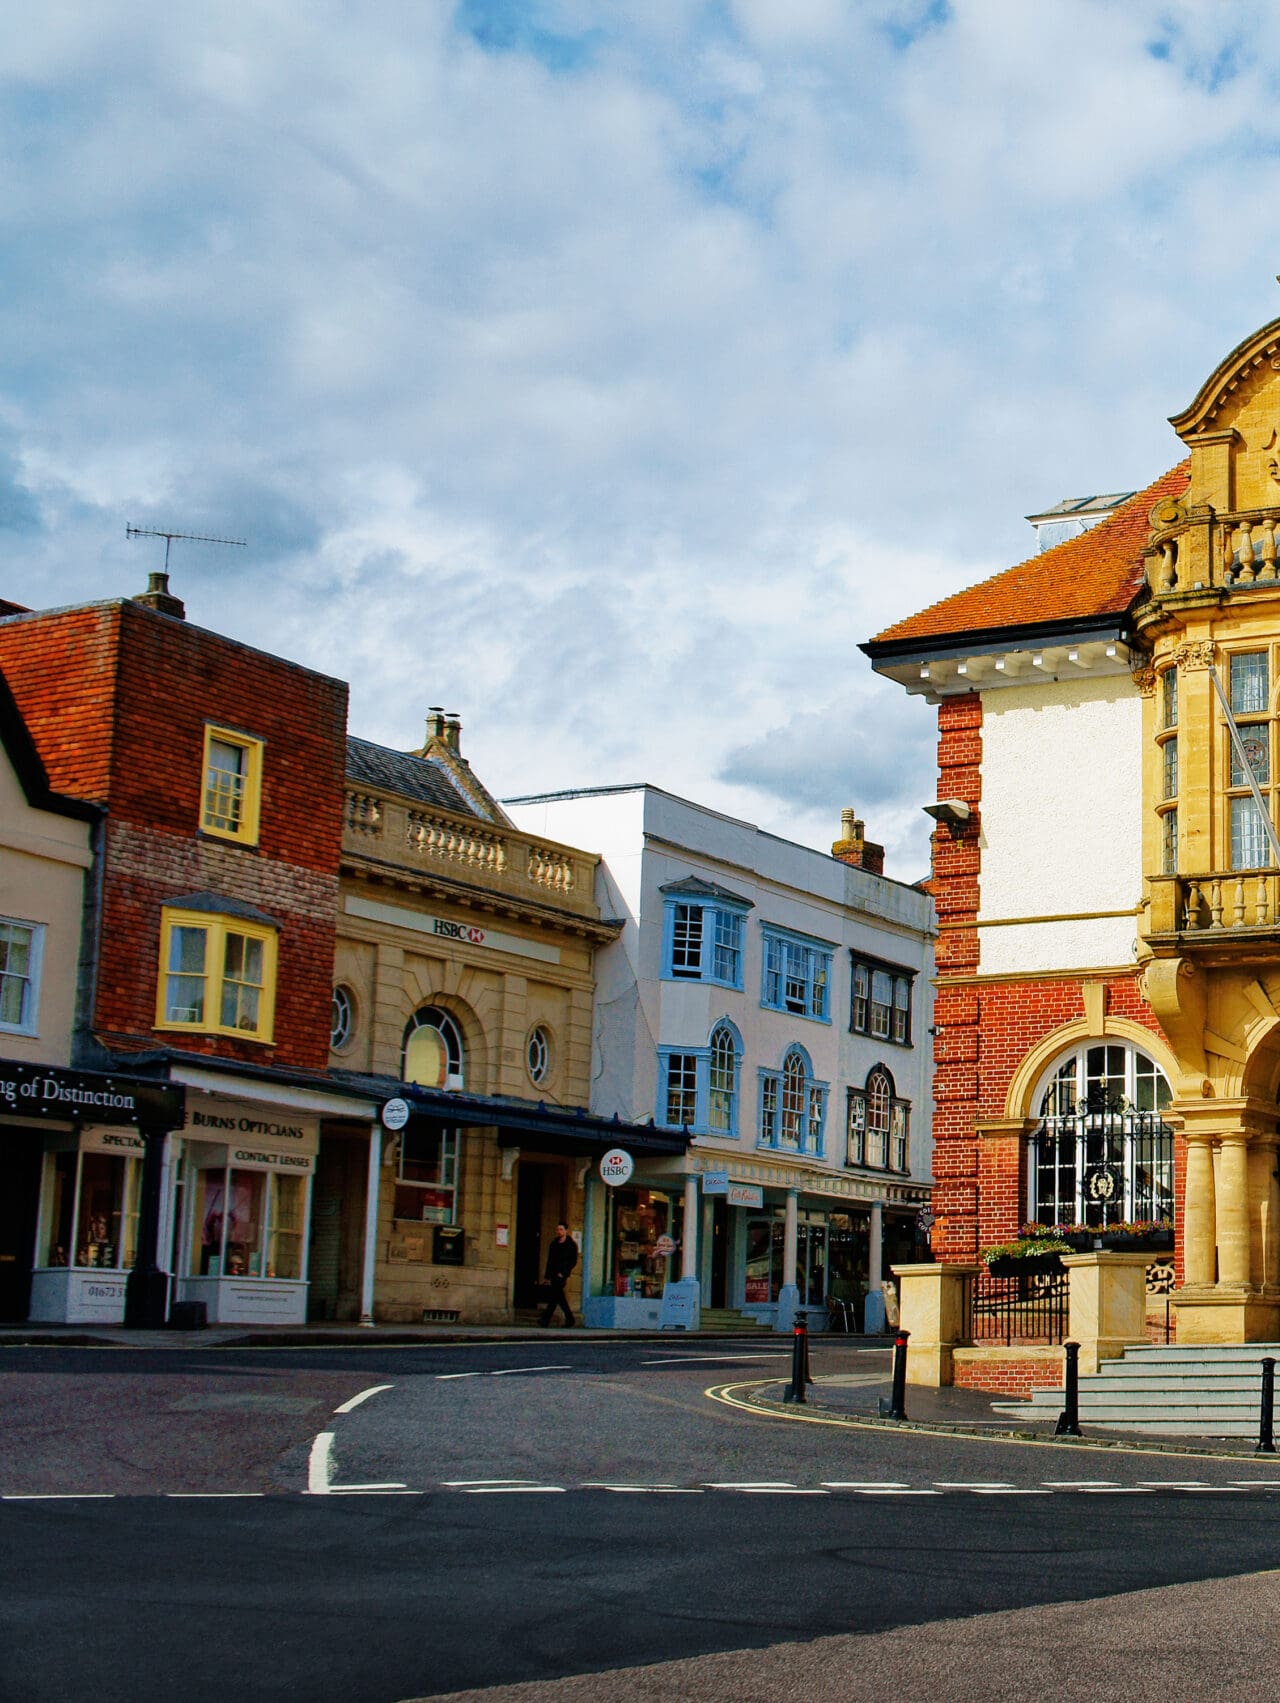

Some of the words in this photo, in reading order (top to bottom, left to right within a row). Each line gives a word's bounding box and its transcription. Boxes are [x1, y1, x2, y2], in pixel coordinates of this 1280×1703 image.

[433, 918, 467, 940] HSBC
[20, 1076, 40, 1097] of
[43, 1079, 135, 1109] Distinction
[192, 1111, 235, 1130] BURNS
[238, 1117, 304, 1139] OPTICIANS
[235, 1150, 277, 1164] CONTACT
[279, 1155, 310, 1167] LENSES
[602, 1166, 628, 1177] HSBC
